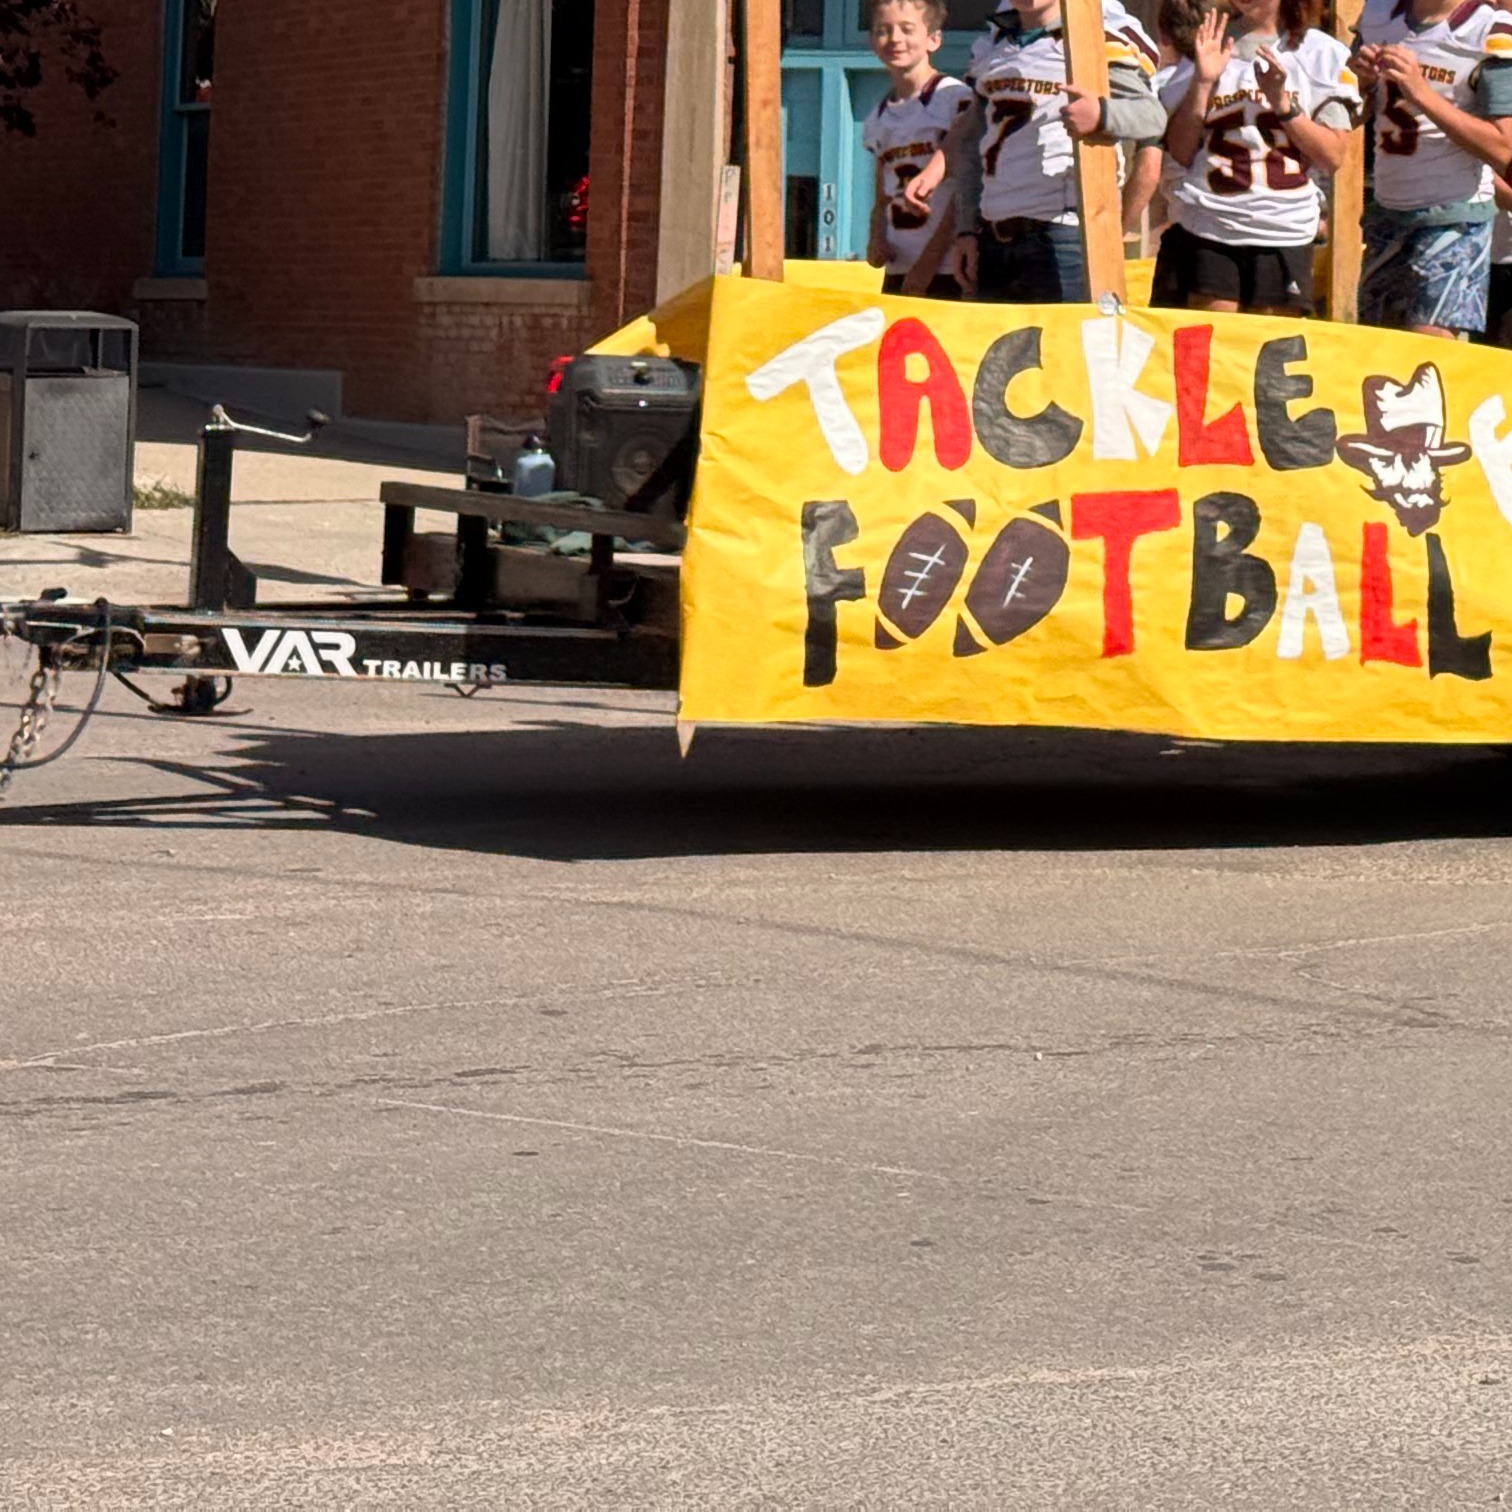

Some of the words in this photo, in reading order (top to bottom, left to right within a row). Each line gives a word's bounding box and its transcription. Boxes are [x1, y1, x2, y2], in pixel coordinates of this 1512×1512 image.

[822, 183, 836, 253] 101
[745, 307, 1338, 475] TACKLE
[801, 487, 1494, 688] FOOTBALL
[220, 627, 359, 676] VAR
[363, 658, 508, 682] TRAILERS
